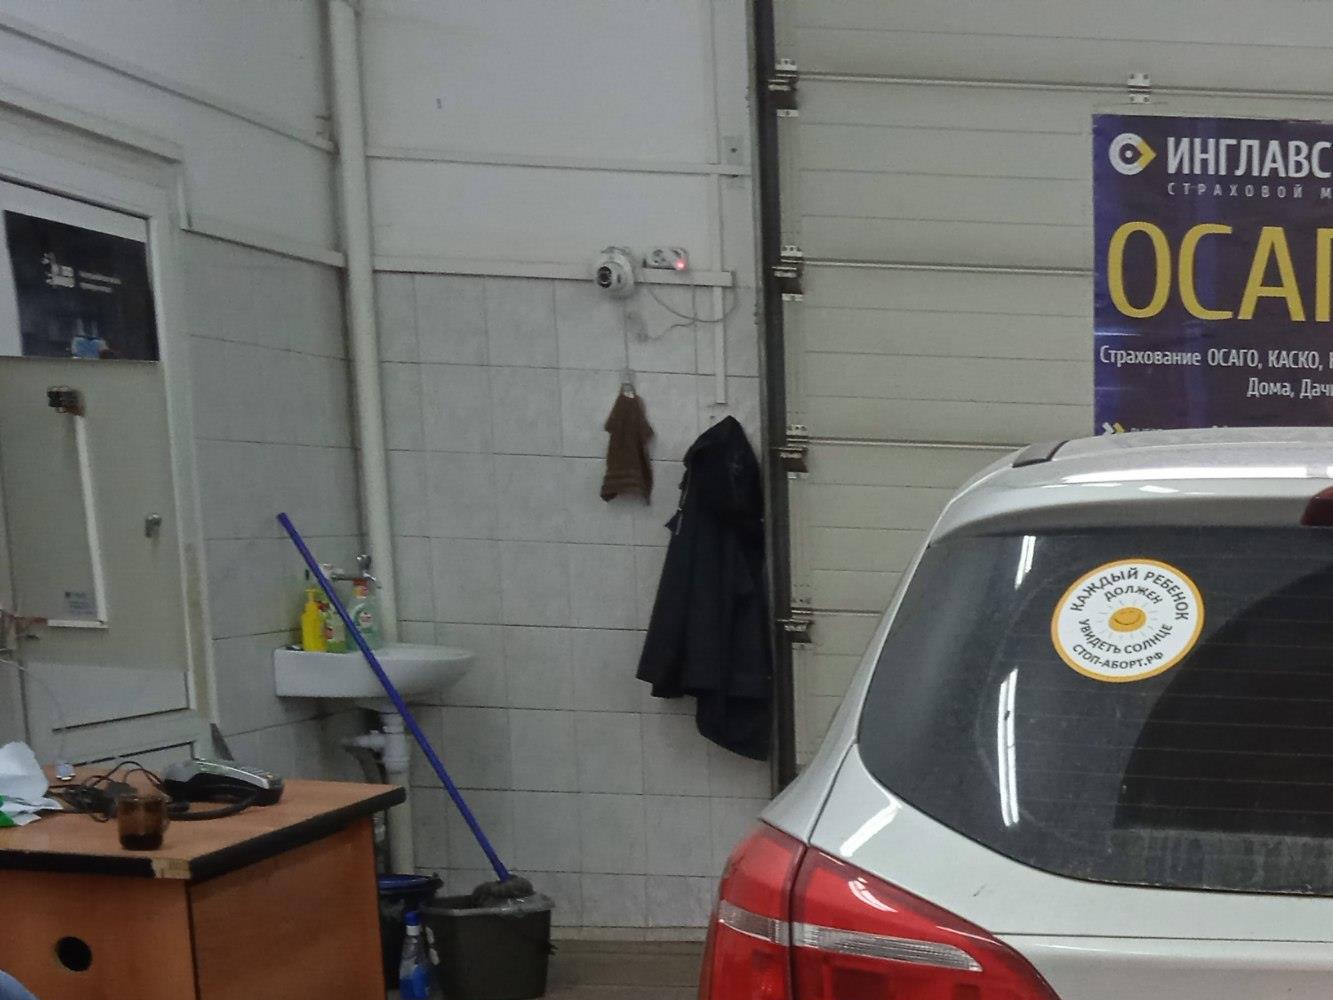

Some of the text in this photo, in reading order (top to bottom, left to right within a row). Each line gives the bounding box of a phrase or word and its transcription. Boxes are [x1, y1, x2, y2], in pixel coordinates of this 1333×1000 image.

[1167, 182, 1303, 199] СТРАХОВОЙ
[1099, 345, 1201, 367] Страхование
[1207, 348, 1263, 369] ОСАГО,
[1268, 350, 1323, 371] КАСКО,
[1246, 377, 1295, 398] Дома,
[1070, 567, 1190, 621] КАЖДЫЙ РЕБЕНОК
[1104, 585, 1163, 604] ДОЛЖЕН
[1079, 618, 1173, 654] УВИДЕТЬ СОЛНЦЕ
[1072, 643, 1164, 670] СТОП-АБОРТ.РФ
